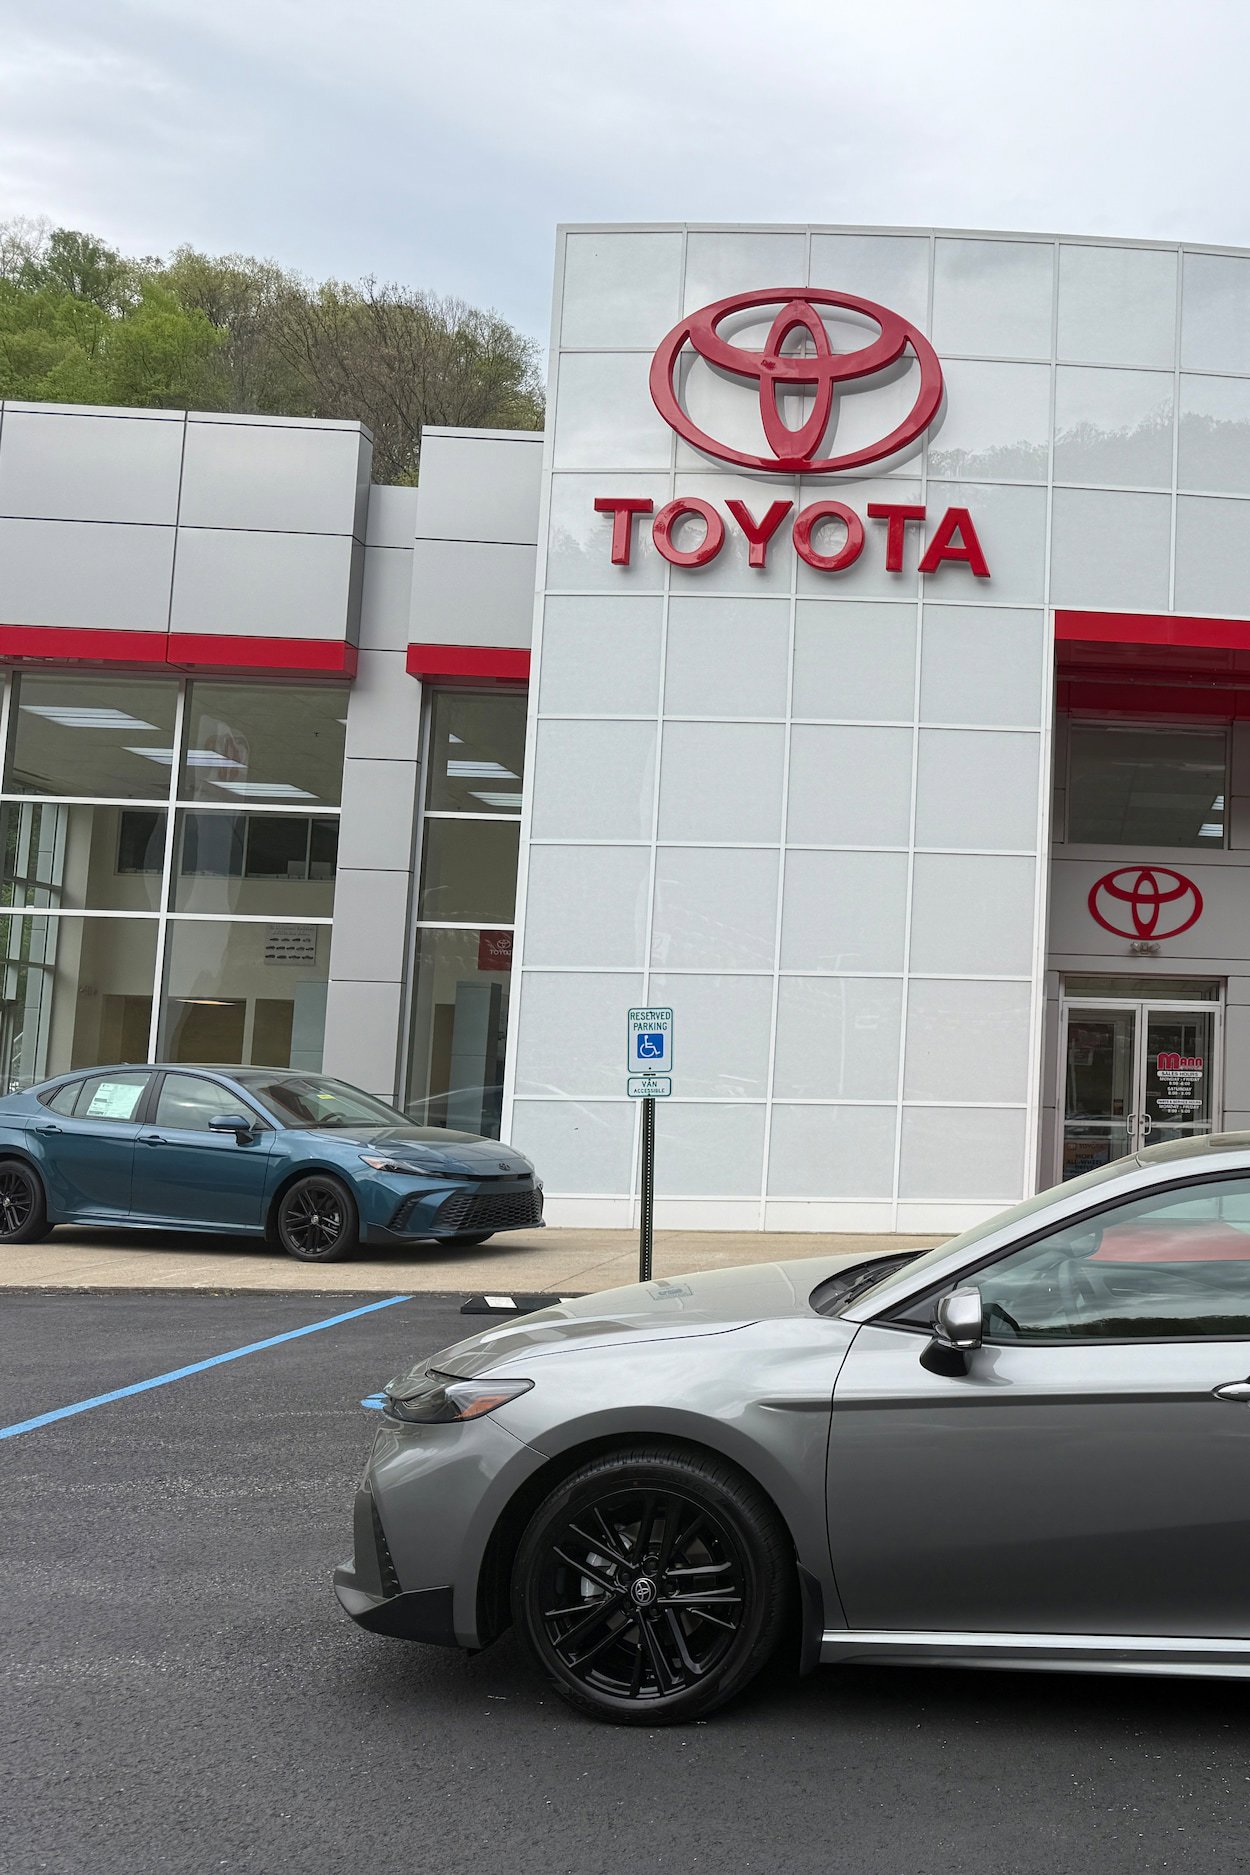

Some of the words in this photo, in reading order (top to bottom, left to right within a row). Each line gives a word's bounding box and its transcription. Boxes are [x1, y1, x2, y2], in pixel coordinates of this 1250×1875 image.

[594, 497, 990, 578] TOYOTA
[630, 1011, 671, 1020] RESERVED
[633, 1022, 668, 1031] PARKING
